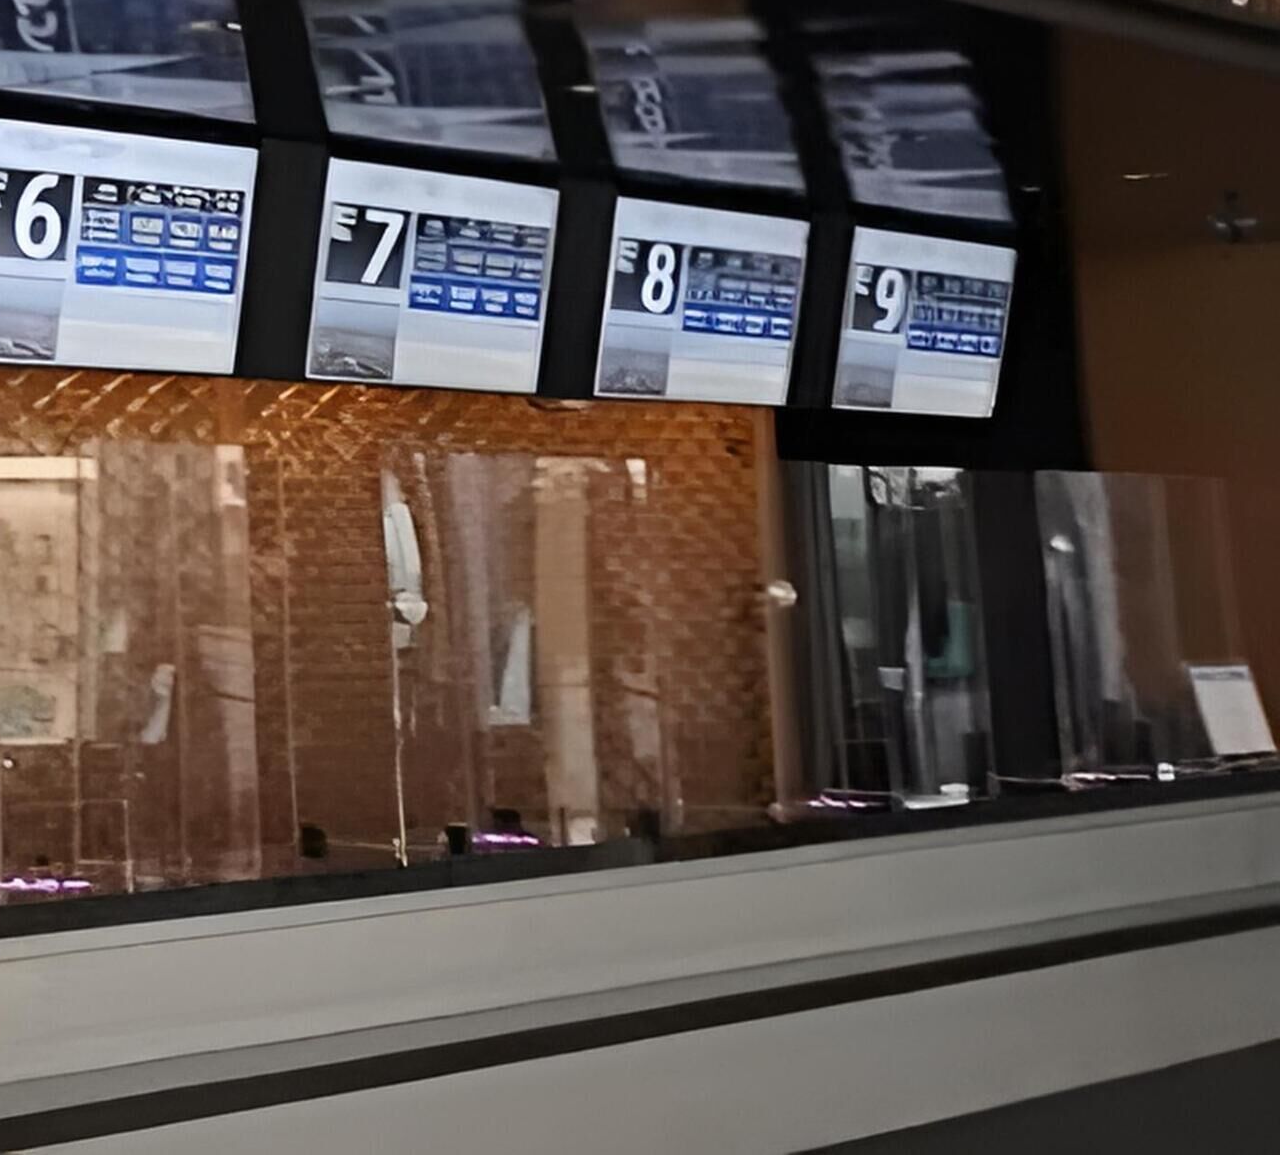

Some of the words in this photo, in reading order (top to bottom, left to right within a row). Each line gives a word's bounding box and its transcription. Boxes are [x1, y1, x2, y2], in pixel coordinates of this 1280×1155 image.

[15, 174, 62, 259] 6
[361, 209, 404, 284] 7
[641, 244, 676, 313] 8
[873, 269, 907, 332] 9
